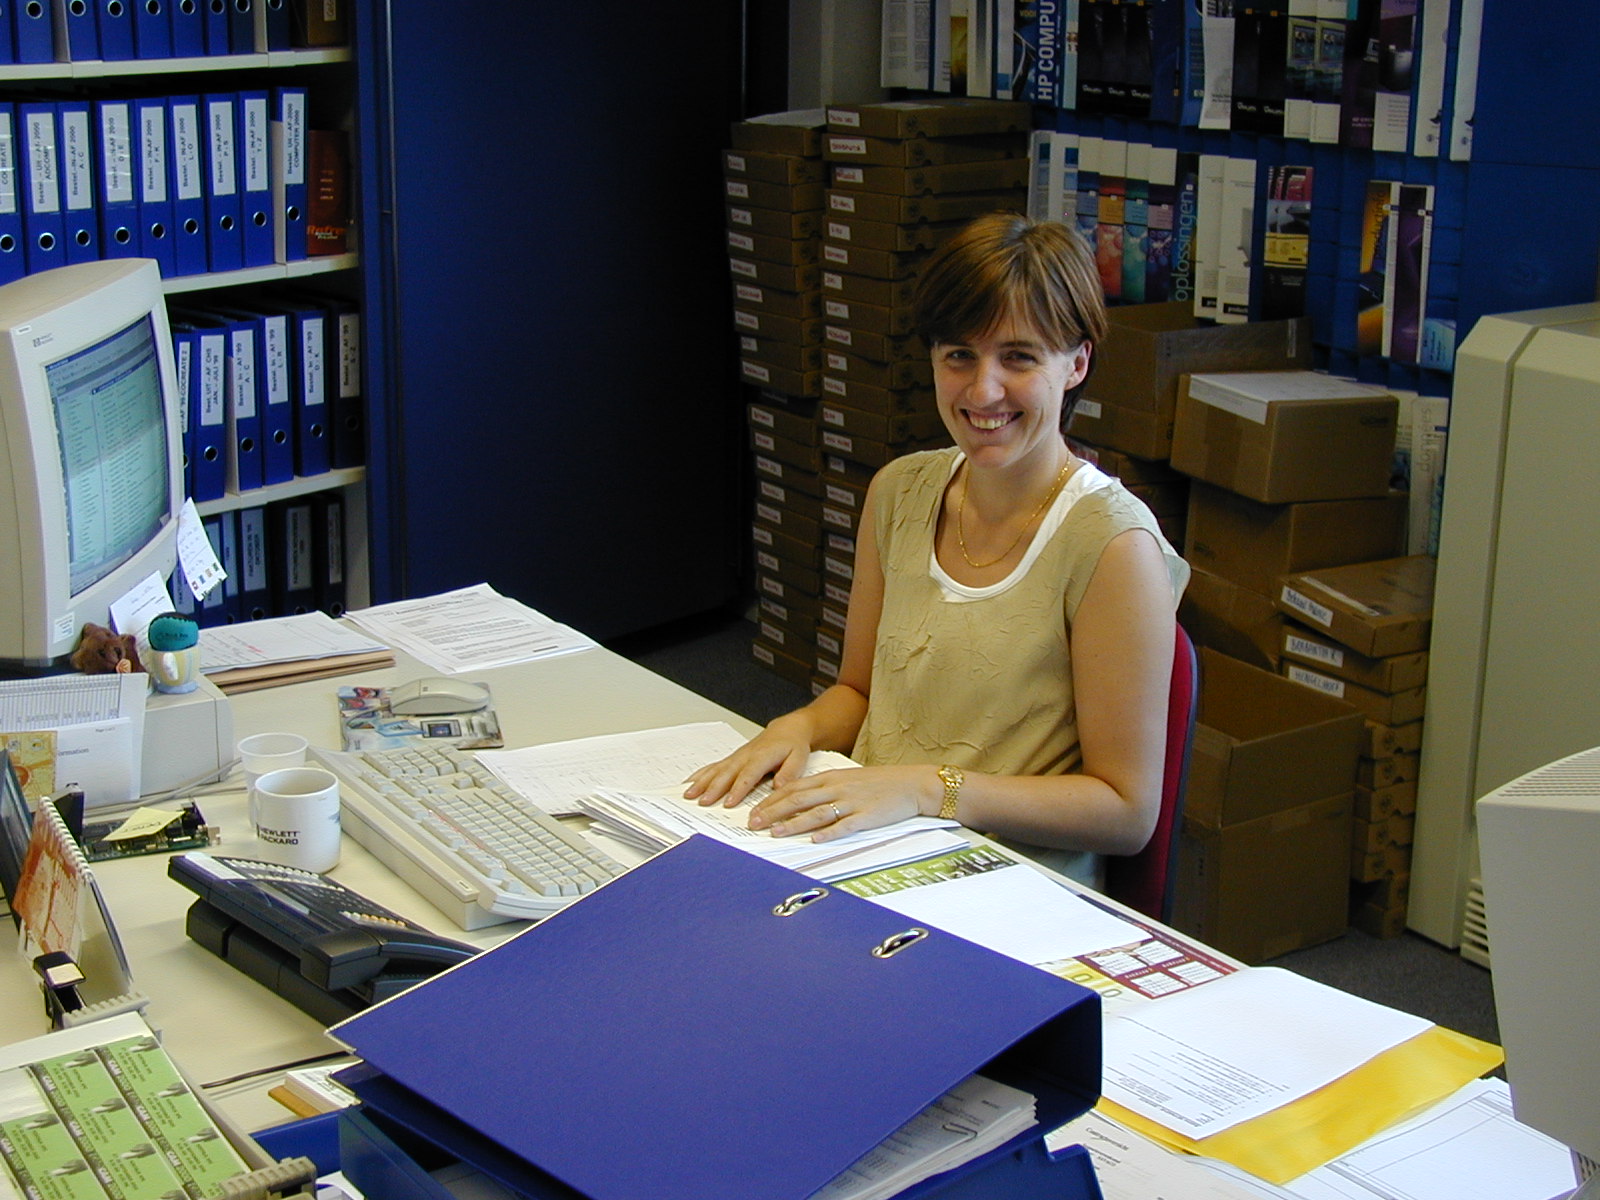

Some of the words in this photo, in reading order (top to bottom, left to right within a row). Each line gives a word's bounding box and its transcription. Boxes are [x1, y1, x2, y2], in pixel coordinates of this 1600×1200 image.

[1038, 0, 1056, 72] COMPU
[1037, 74, 1053, 100] HP
[1171, 190, 1197, 301] oplossingen
[206, 367, 211, 376] AF
[260, 834, 298, 846] PACKARD
